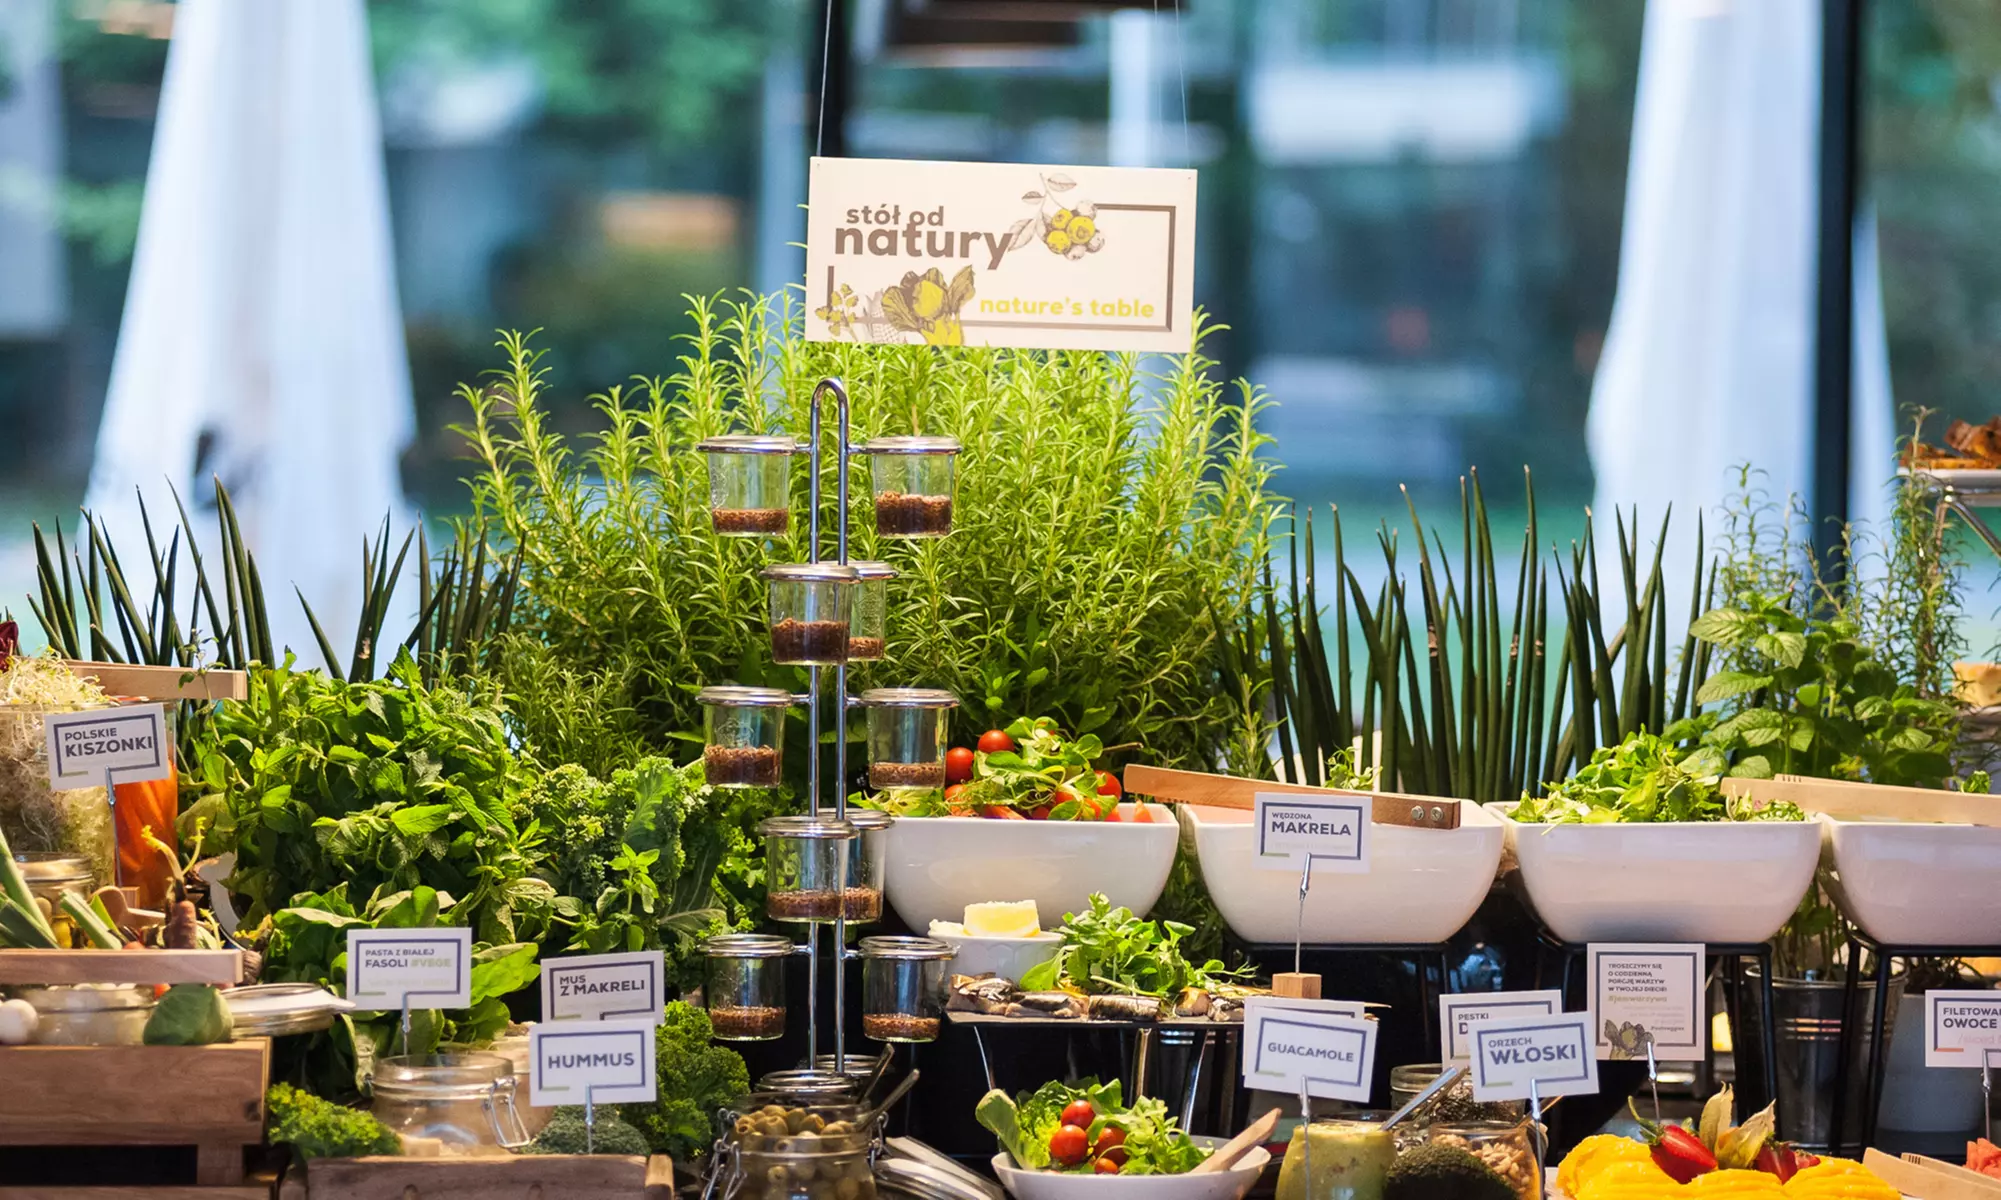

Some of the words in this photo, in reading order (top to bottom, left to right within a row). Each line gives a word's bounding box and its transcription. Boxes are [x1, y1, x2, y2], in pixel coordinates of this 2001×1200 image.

[846, 203, 900, 226] stół
[908, 205, 944, 227] od
[835, 222, 1014, 270] natury
[980, 297, 1083, 317] nature's
[1089, 297, 1154, 319] table
[64, 728, 117, 741] POLSKIE
[65, 736, 153, 757] KISZONKI
[1272, 812, 1312, 820] WĘDZONA
[1272, 821, 1351, 836] MAKRELA
[365, 949, 394, 957] PASTA
[396, 949, 401, 957] Z
[365, 958, 408, 968] FASOLI
[559, 975, 586, 985] MUS
[560, 985, 569, 996] Z
[574, 980, 645, 995] MAKRELI
[1458, 1013, 1489, 1021] PESTKI
[1943, 1007, 2001, 1016] FILETOWA
[1943, 1018, 1998, 1029] OWOCE
[1488, 1037, 1532, 1048] ORZECH
[1268, 1042, 1354, 1062] GUACAMOLE
[1490, 1044, 1576, 1065] WŁOSKI
[548, 1053, 635, 1069] HUMMUS
